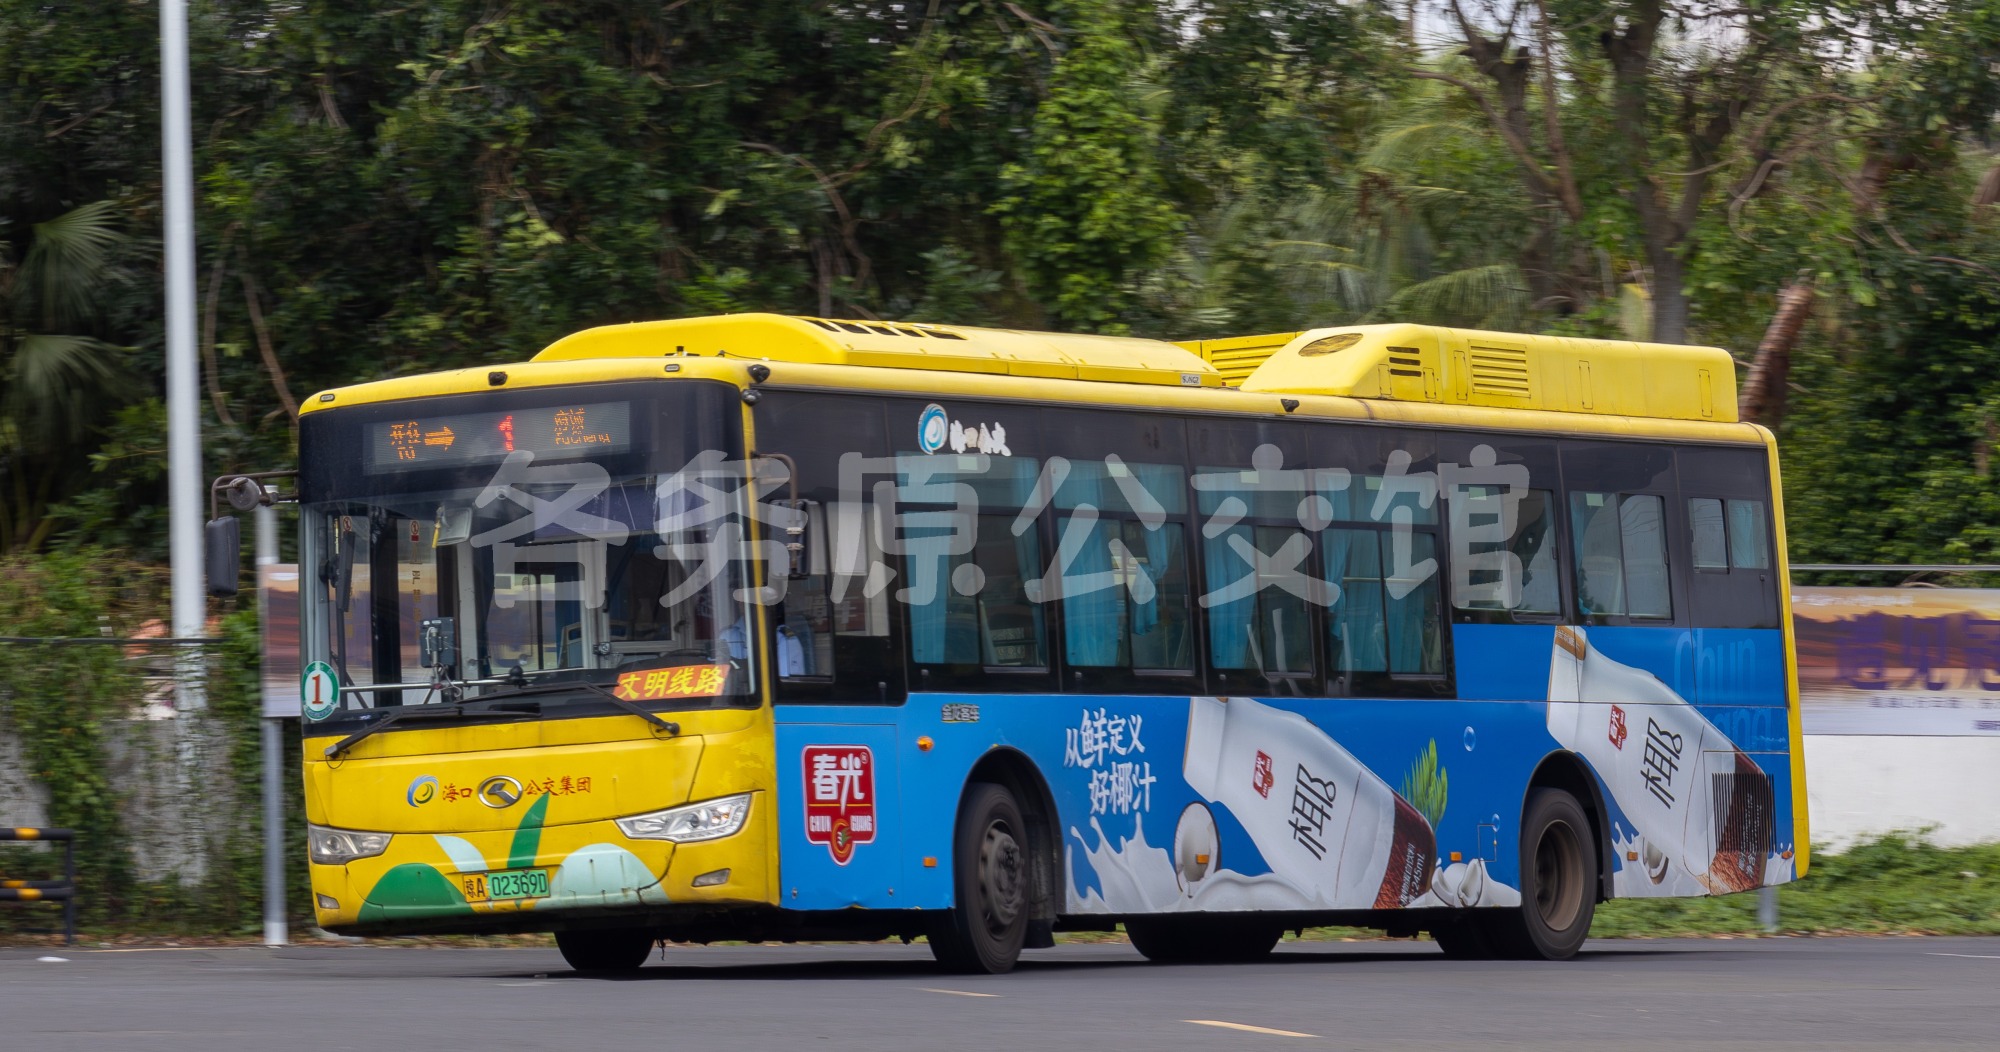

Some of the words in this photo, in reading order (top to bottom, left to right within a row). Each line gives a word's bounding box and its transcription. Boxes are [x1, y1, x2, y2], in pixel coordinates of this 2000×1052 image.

[499, 415, 514, 450] 1
[311, 673, 324, 705] 1
[618, 666, 725, 700] 文明线路
[1063, 707, 1146, 768] 从鲜定义
[442, 783, 474, 803] 海口
[524, 775, 592, 796] 公交集团
[812, 753, 865, 816] 春光
[1088, 761, 1157, 815] 好椰汁
